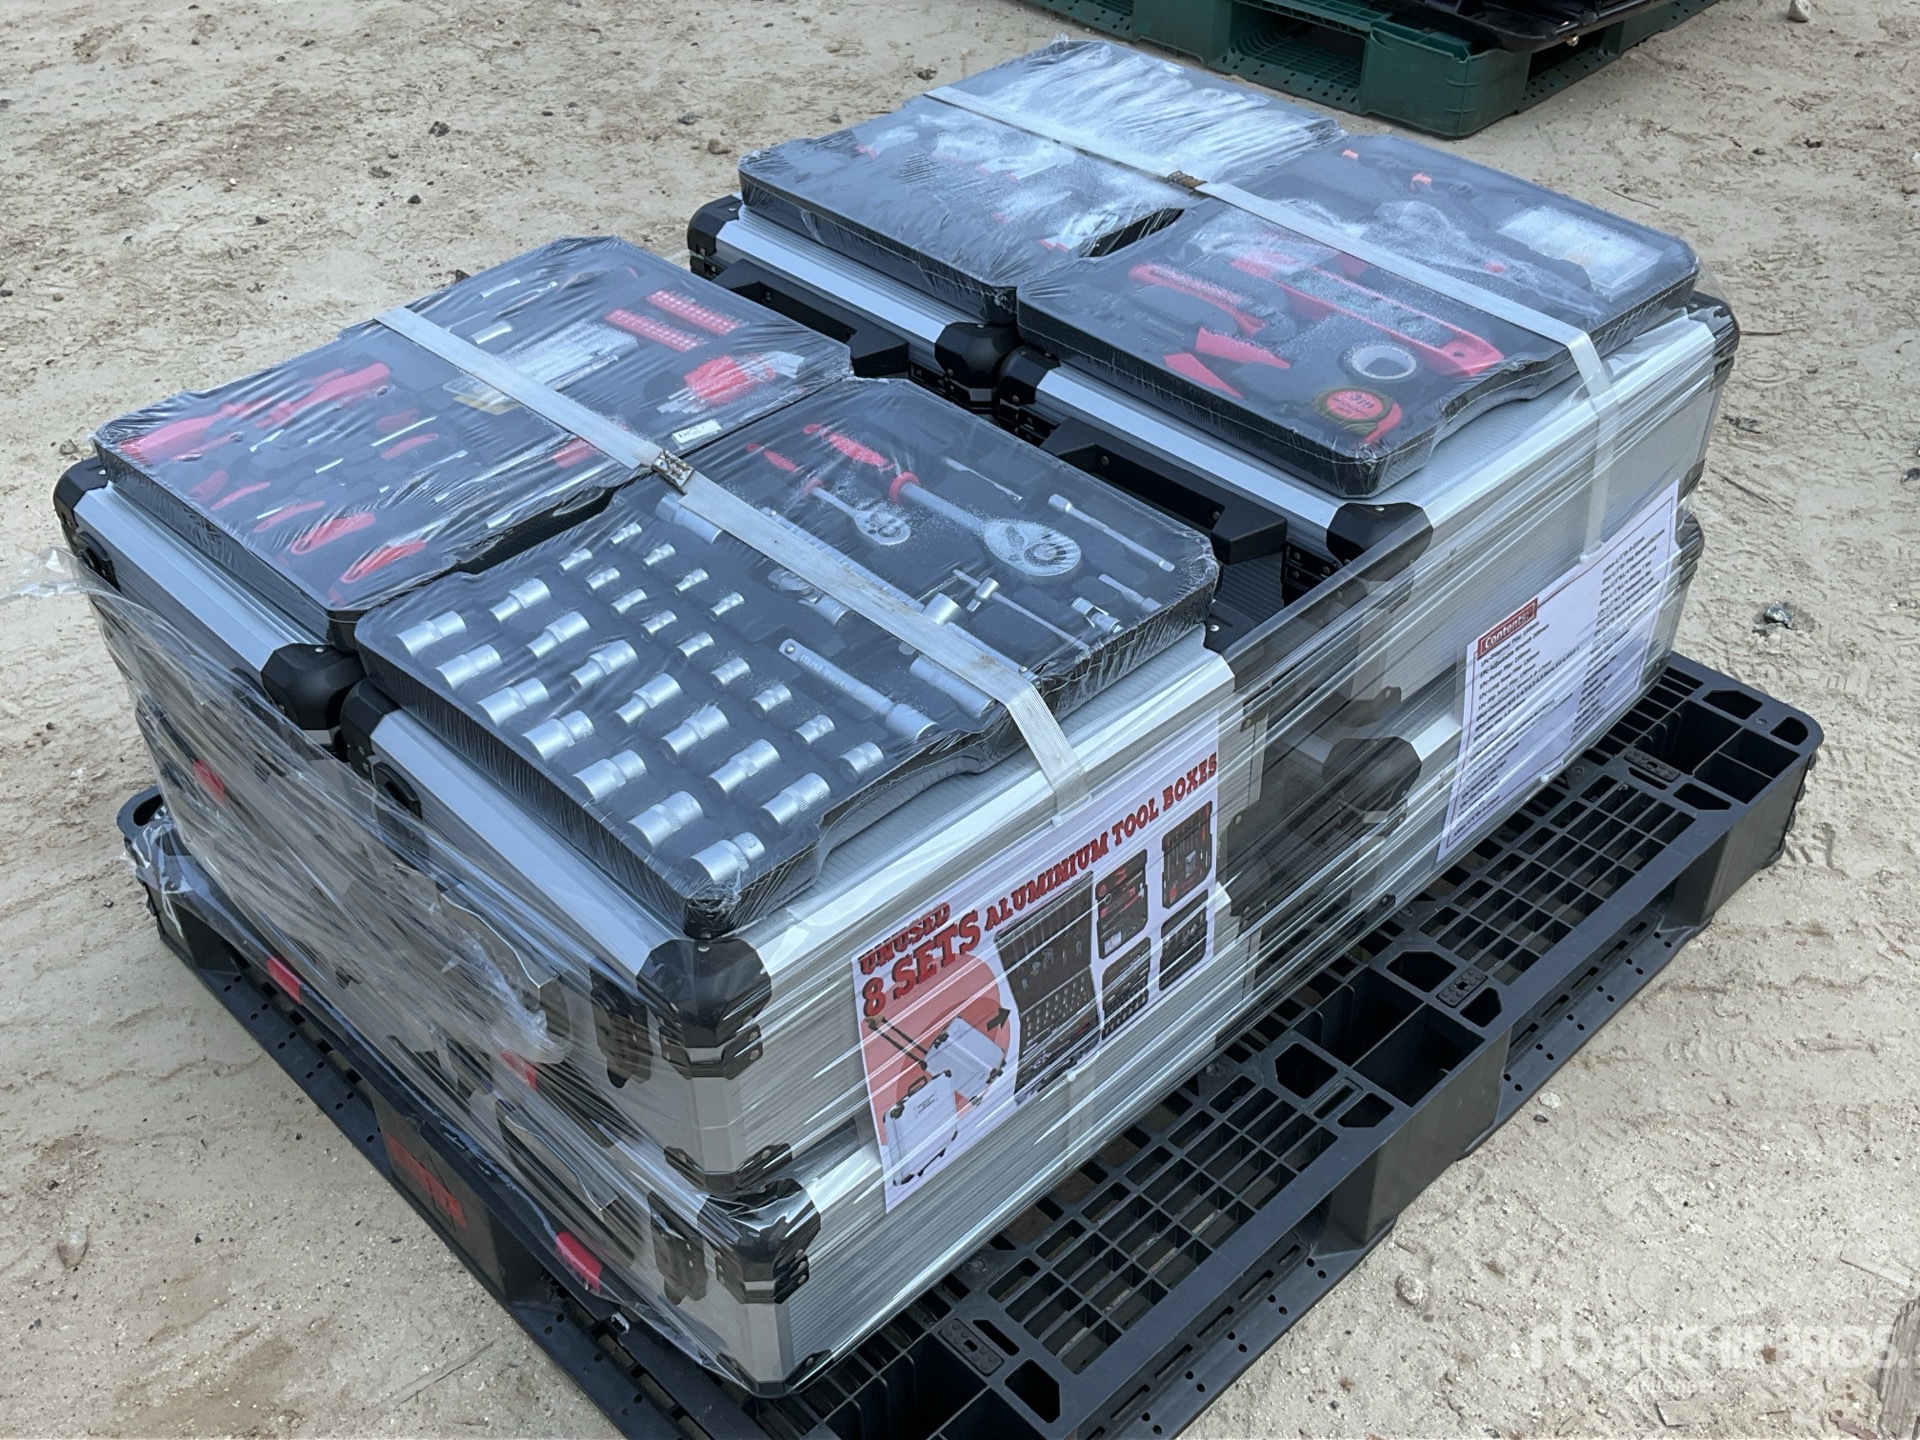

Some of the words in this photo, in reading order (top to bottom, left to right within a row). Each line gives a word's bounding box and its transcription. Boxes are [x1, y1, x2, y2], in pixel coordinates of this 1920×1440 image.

[858, 902, 950, 975] UNUSED
[862, 977, 886, 1017] 8
[892, 909, 981, 1000] SETS
[985, 831, 1109, 931] ALUMINIUM
[1112, 798, 1159, 847] TOOL
[1163, 752, 1217, 812] BOXES
